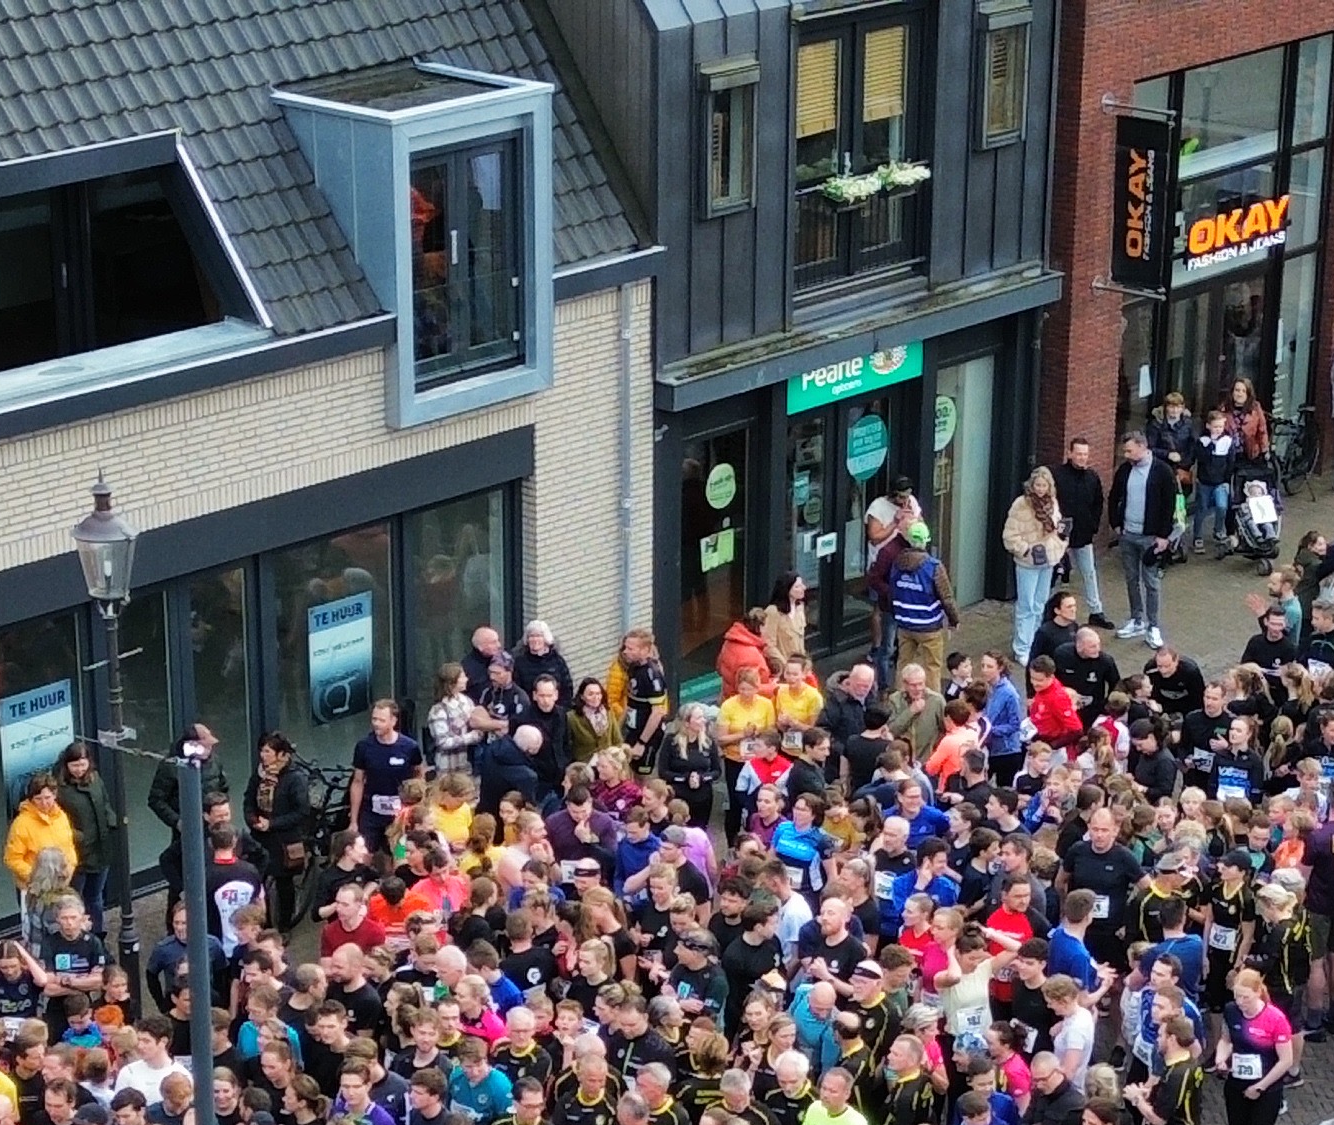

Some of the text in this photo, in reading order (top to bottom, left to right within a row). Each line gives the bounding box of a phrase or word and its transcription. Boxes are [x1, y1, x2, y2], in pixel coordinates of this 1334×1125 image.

[1126, 148, 1147, 258] OKAY
[1189, 194, 1290, 255] OKAY
[1187, 245, 1238, 271] FASHION
[1239, 242, 1248, 257] &
[314, 602, 364, 627] TE HUUR
[9, 690, 66, 718] TE HUUR
